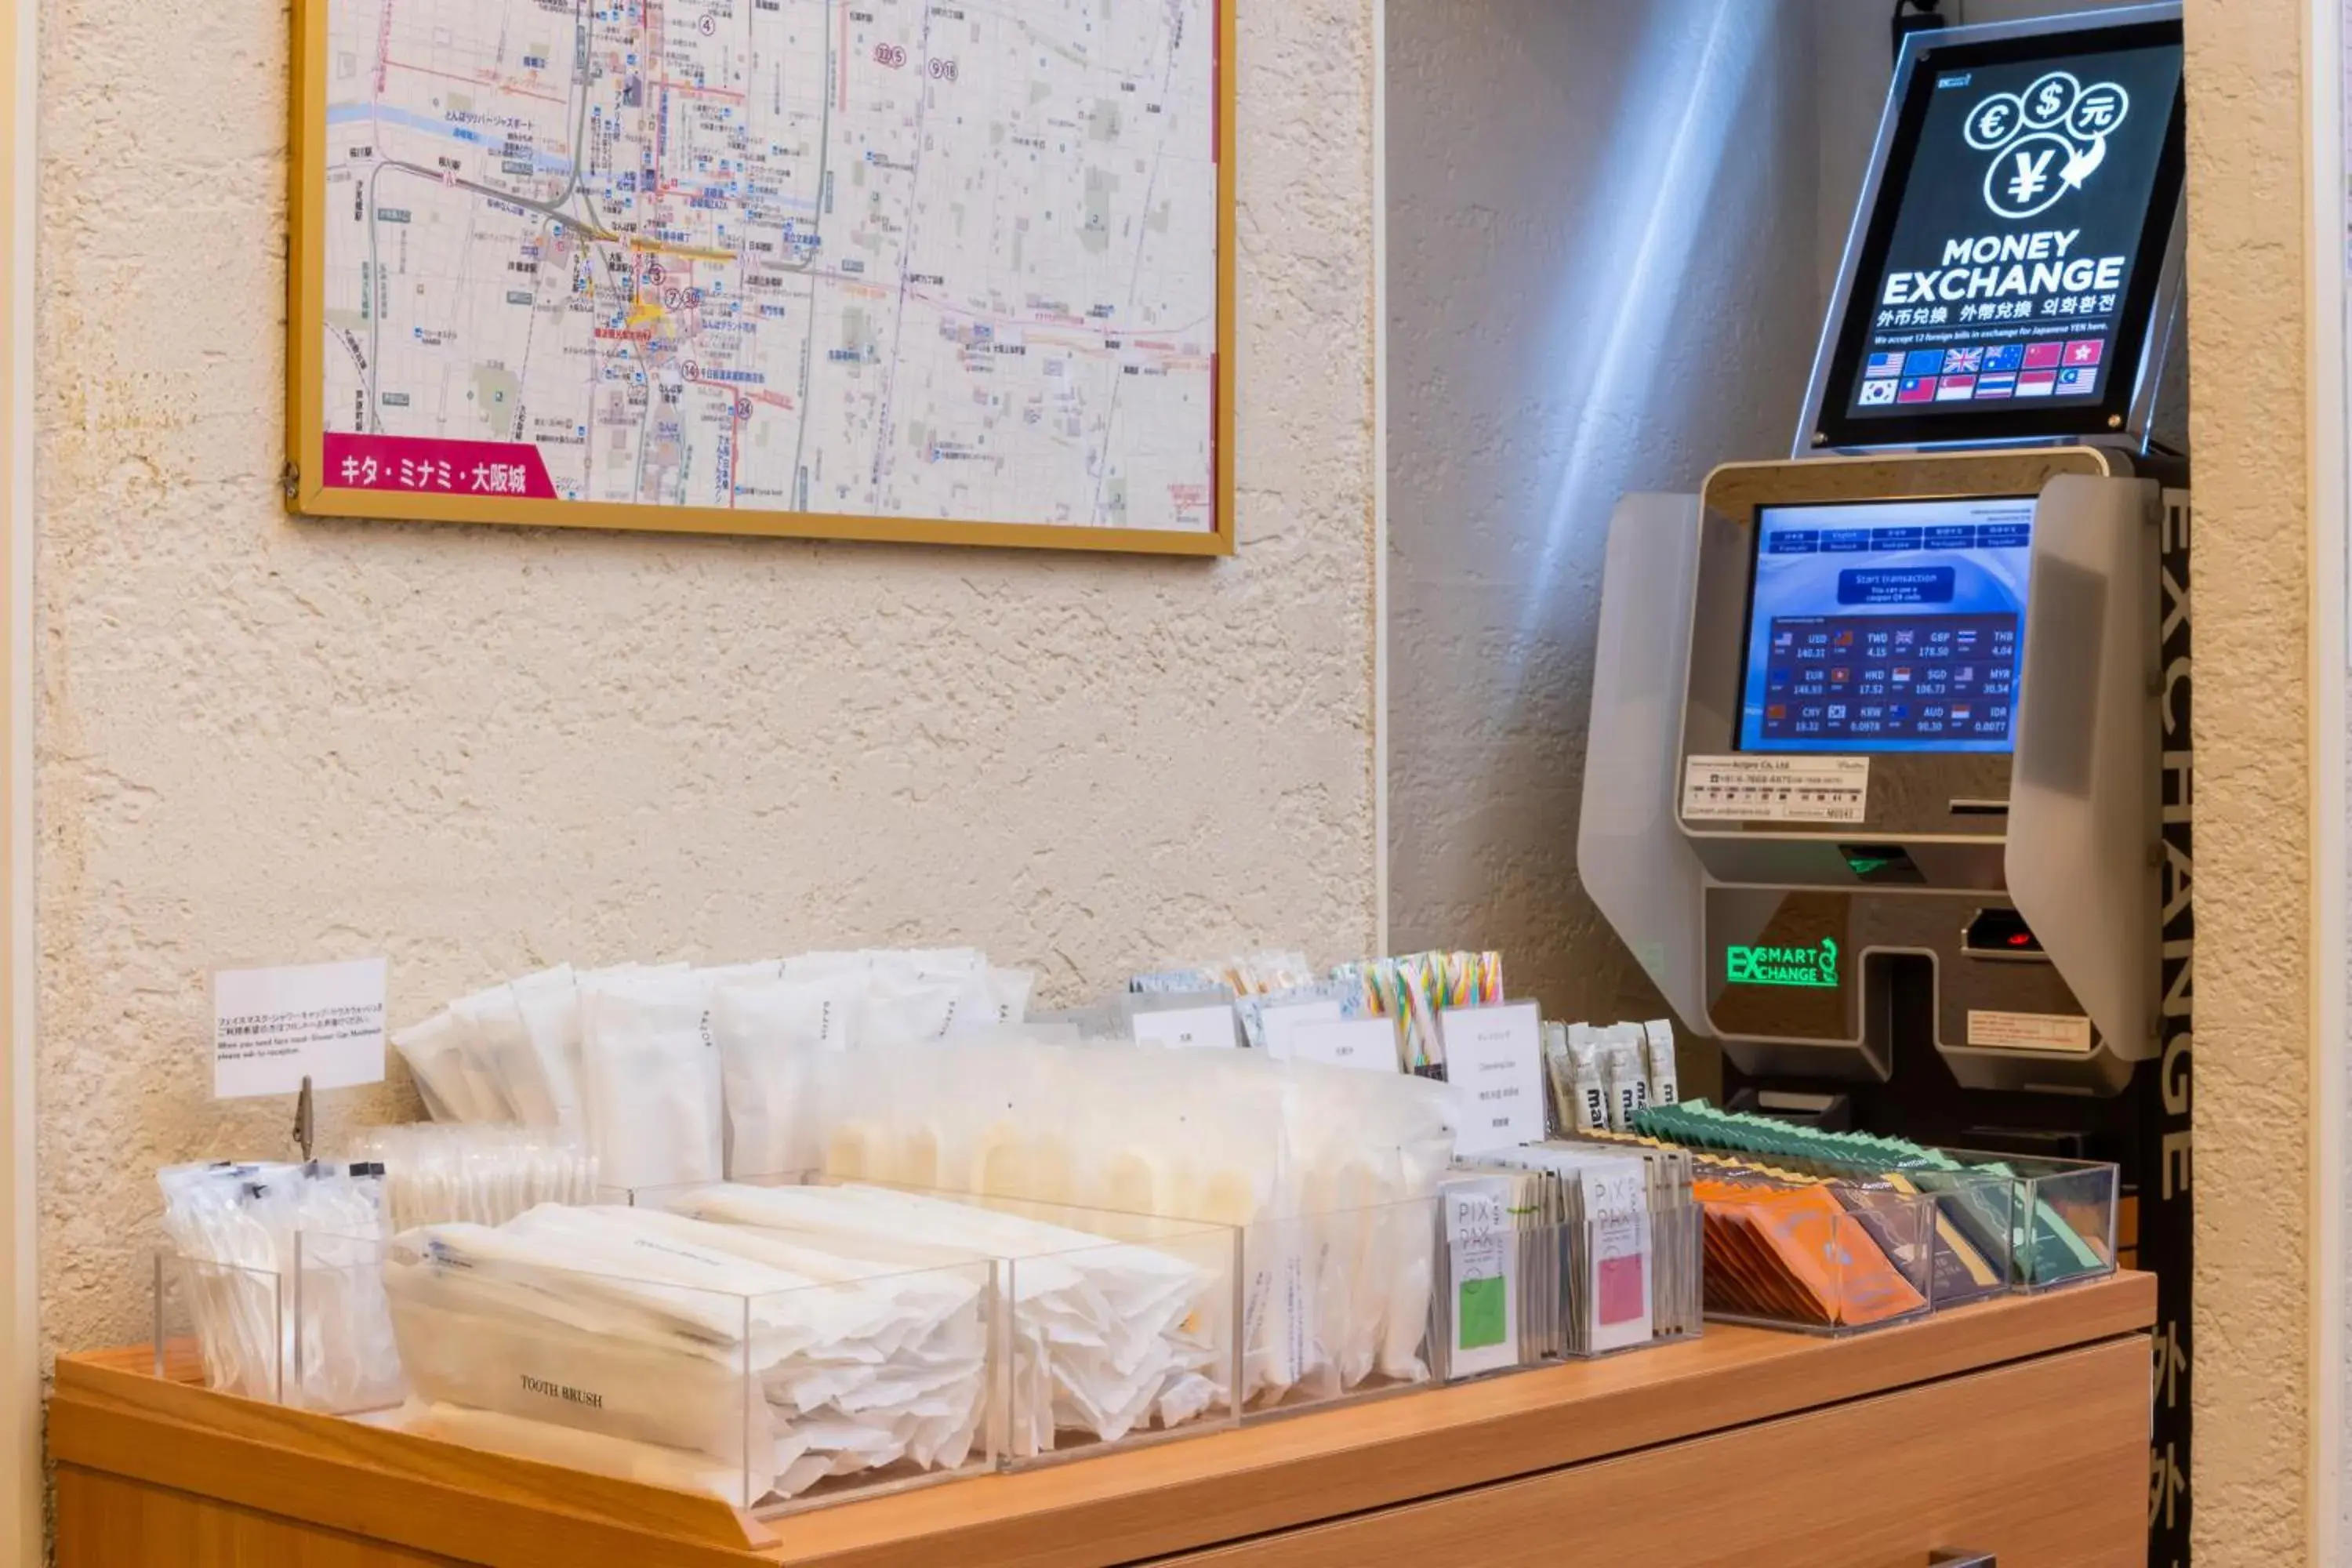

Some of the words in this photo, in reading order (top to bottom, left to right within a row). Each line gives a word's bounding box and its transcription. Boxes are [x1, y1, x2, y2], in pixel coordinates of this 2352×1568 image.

[1942, 229, 2080, 267] MONEY
[1882, 256, 2126, 306] EXCHANGE
[1915, 333, 1924, 343] 12
[2071, 323, 2086, 332] YEN
[341, 455, 526, 494] キタ・ミナミ・大阪城
[1856, 575, 1881, 584] Start
[1882, 573, 1937, 584] transaction
[1929, 632, 1950, 641] GBP
[1759, 948, 1817, 964] SMART
[1595, 1178, 1625, 1203] PIX
[1459, 1201, 1489, 1224] PIX
[1460, 1225, 1494, 1250] PAX
[521, 1374, 559, 1398] TOOTH
[561, 1385, 604, 1410] BRUSH
